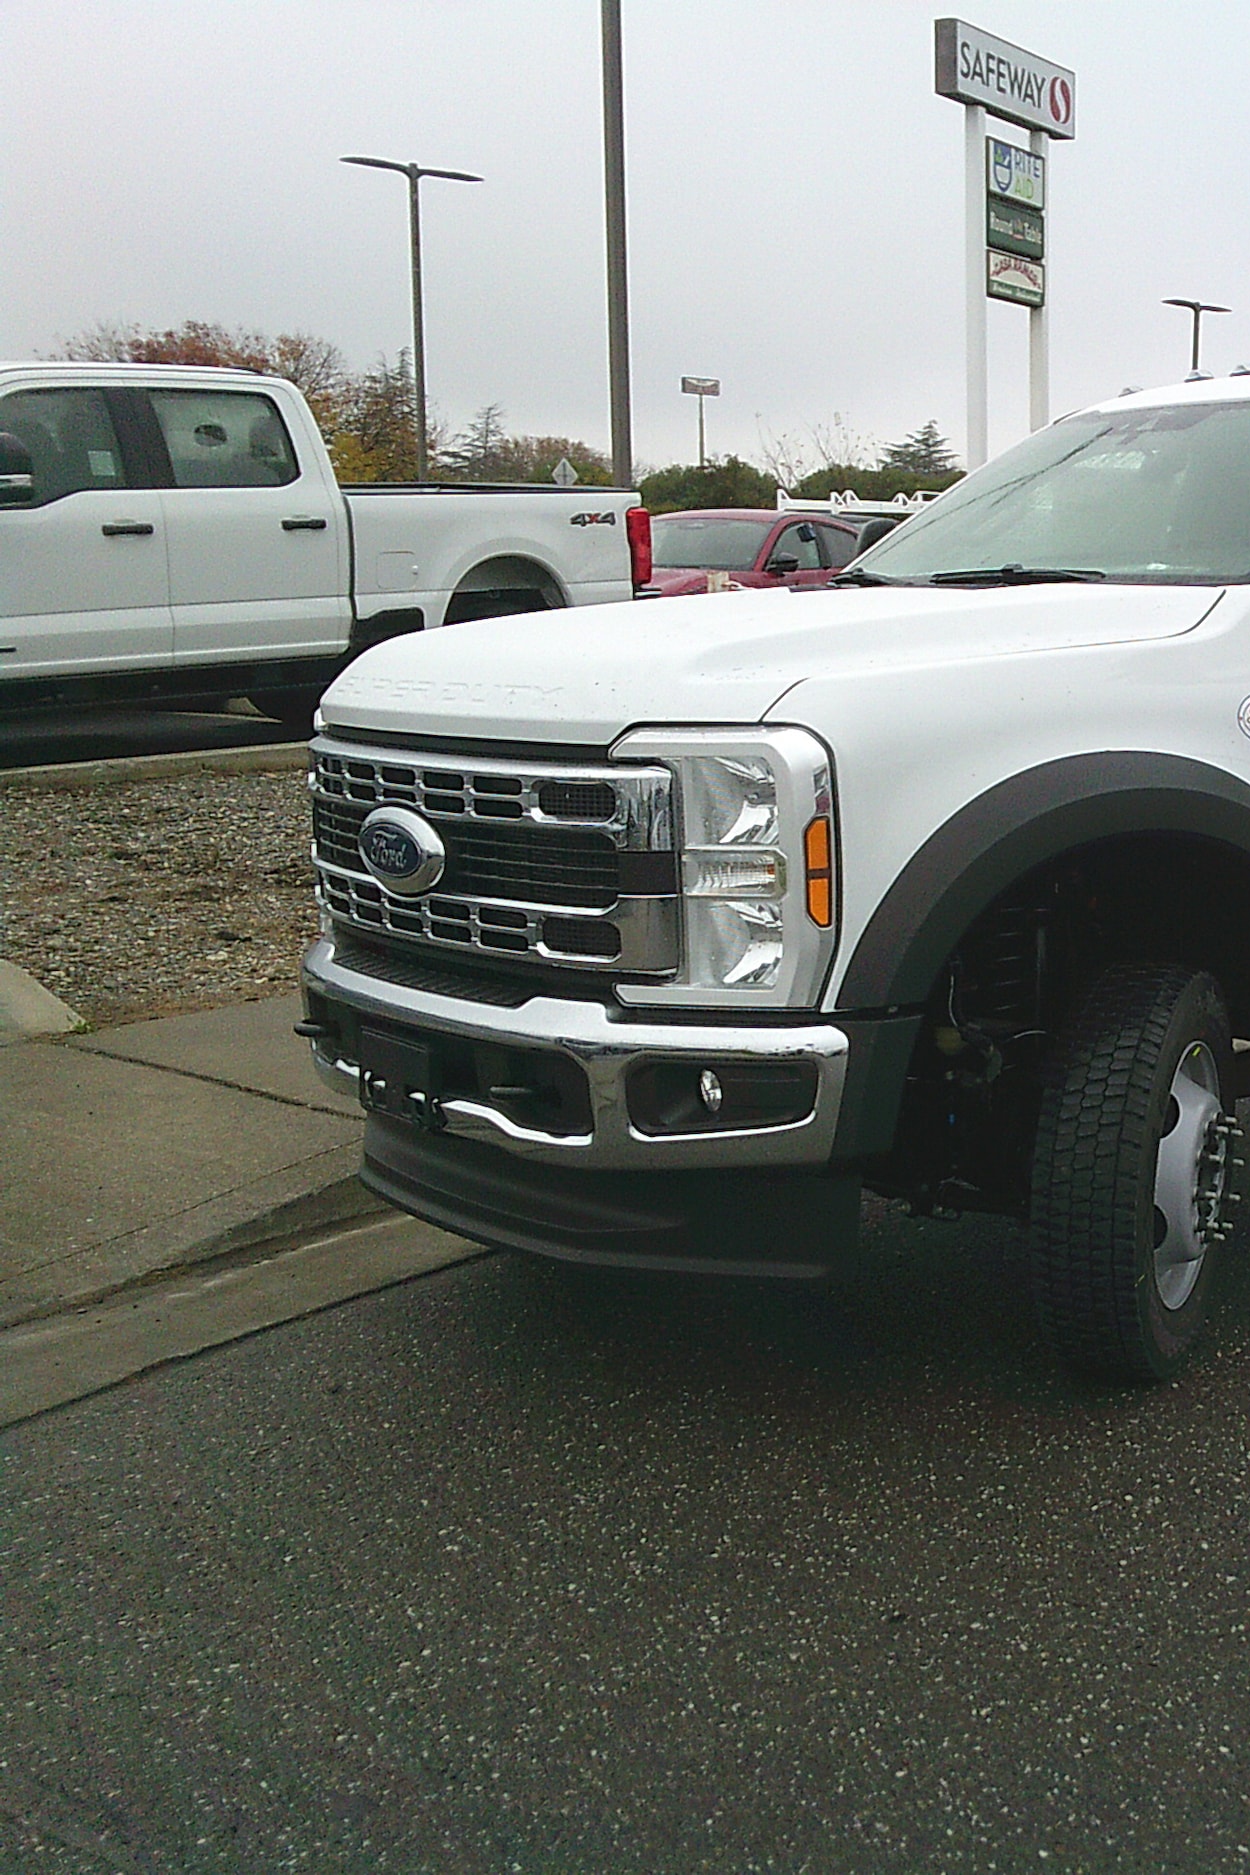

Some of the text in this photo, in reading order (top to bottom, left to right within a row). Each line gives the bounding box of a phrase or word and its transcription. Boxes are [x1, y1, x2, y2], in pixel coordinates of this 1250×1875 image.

[960, 41, 1046, 109] SAFEWAY
[1014, 149, 1040, 178] RITE
[1014, 175, 1034, 199] AID
[370, 829, 409, 869] Ford
